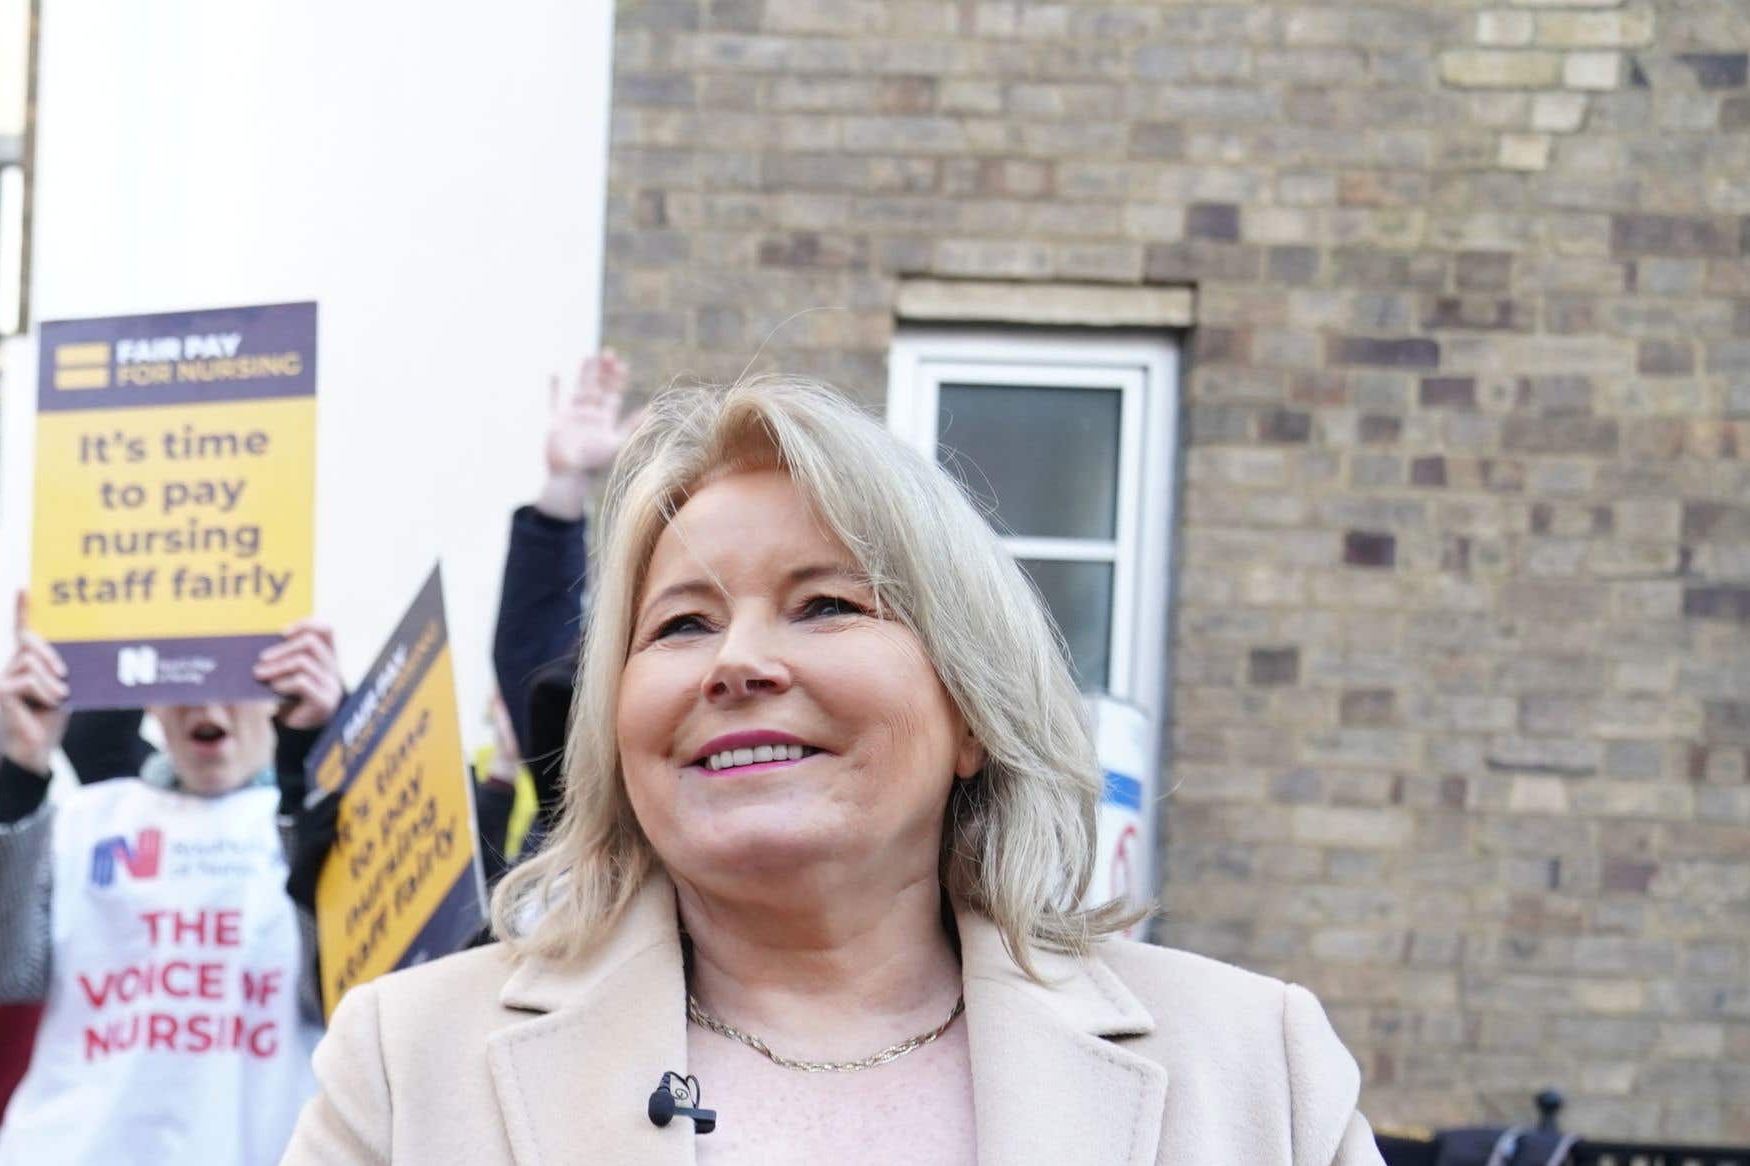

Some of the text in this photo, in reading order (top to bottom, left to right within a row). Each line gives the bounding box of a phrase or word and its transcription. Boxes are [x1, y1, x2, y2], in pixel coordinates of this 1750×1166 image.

[116, 334, 242, 363] FAIR PAY
[117, 352, 303, 387] FOR NURSING
[78, 425, 270, 463] It's time
[101, 479, 246, 513] to pay
[81, 520, 261, 557] nursing
[51, 563, 293, 604] staff fairly
[345, 795, 438, 938] nursing
[141, 911, 242, 947] THE
[79, 962, 225, 1010] VOICE
